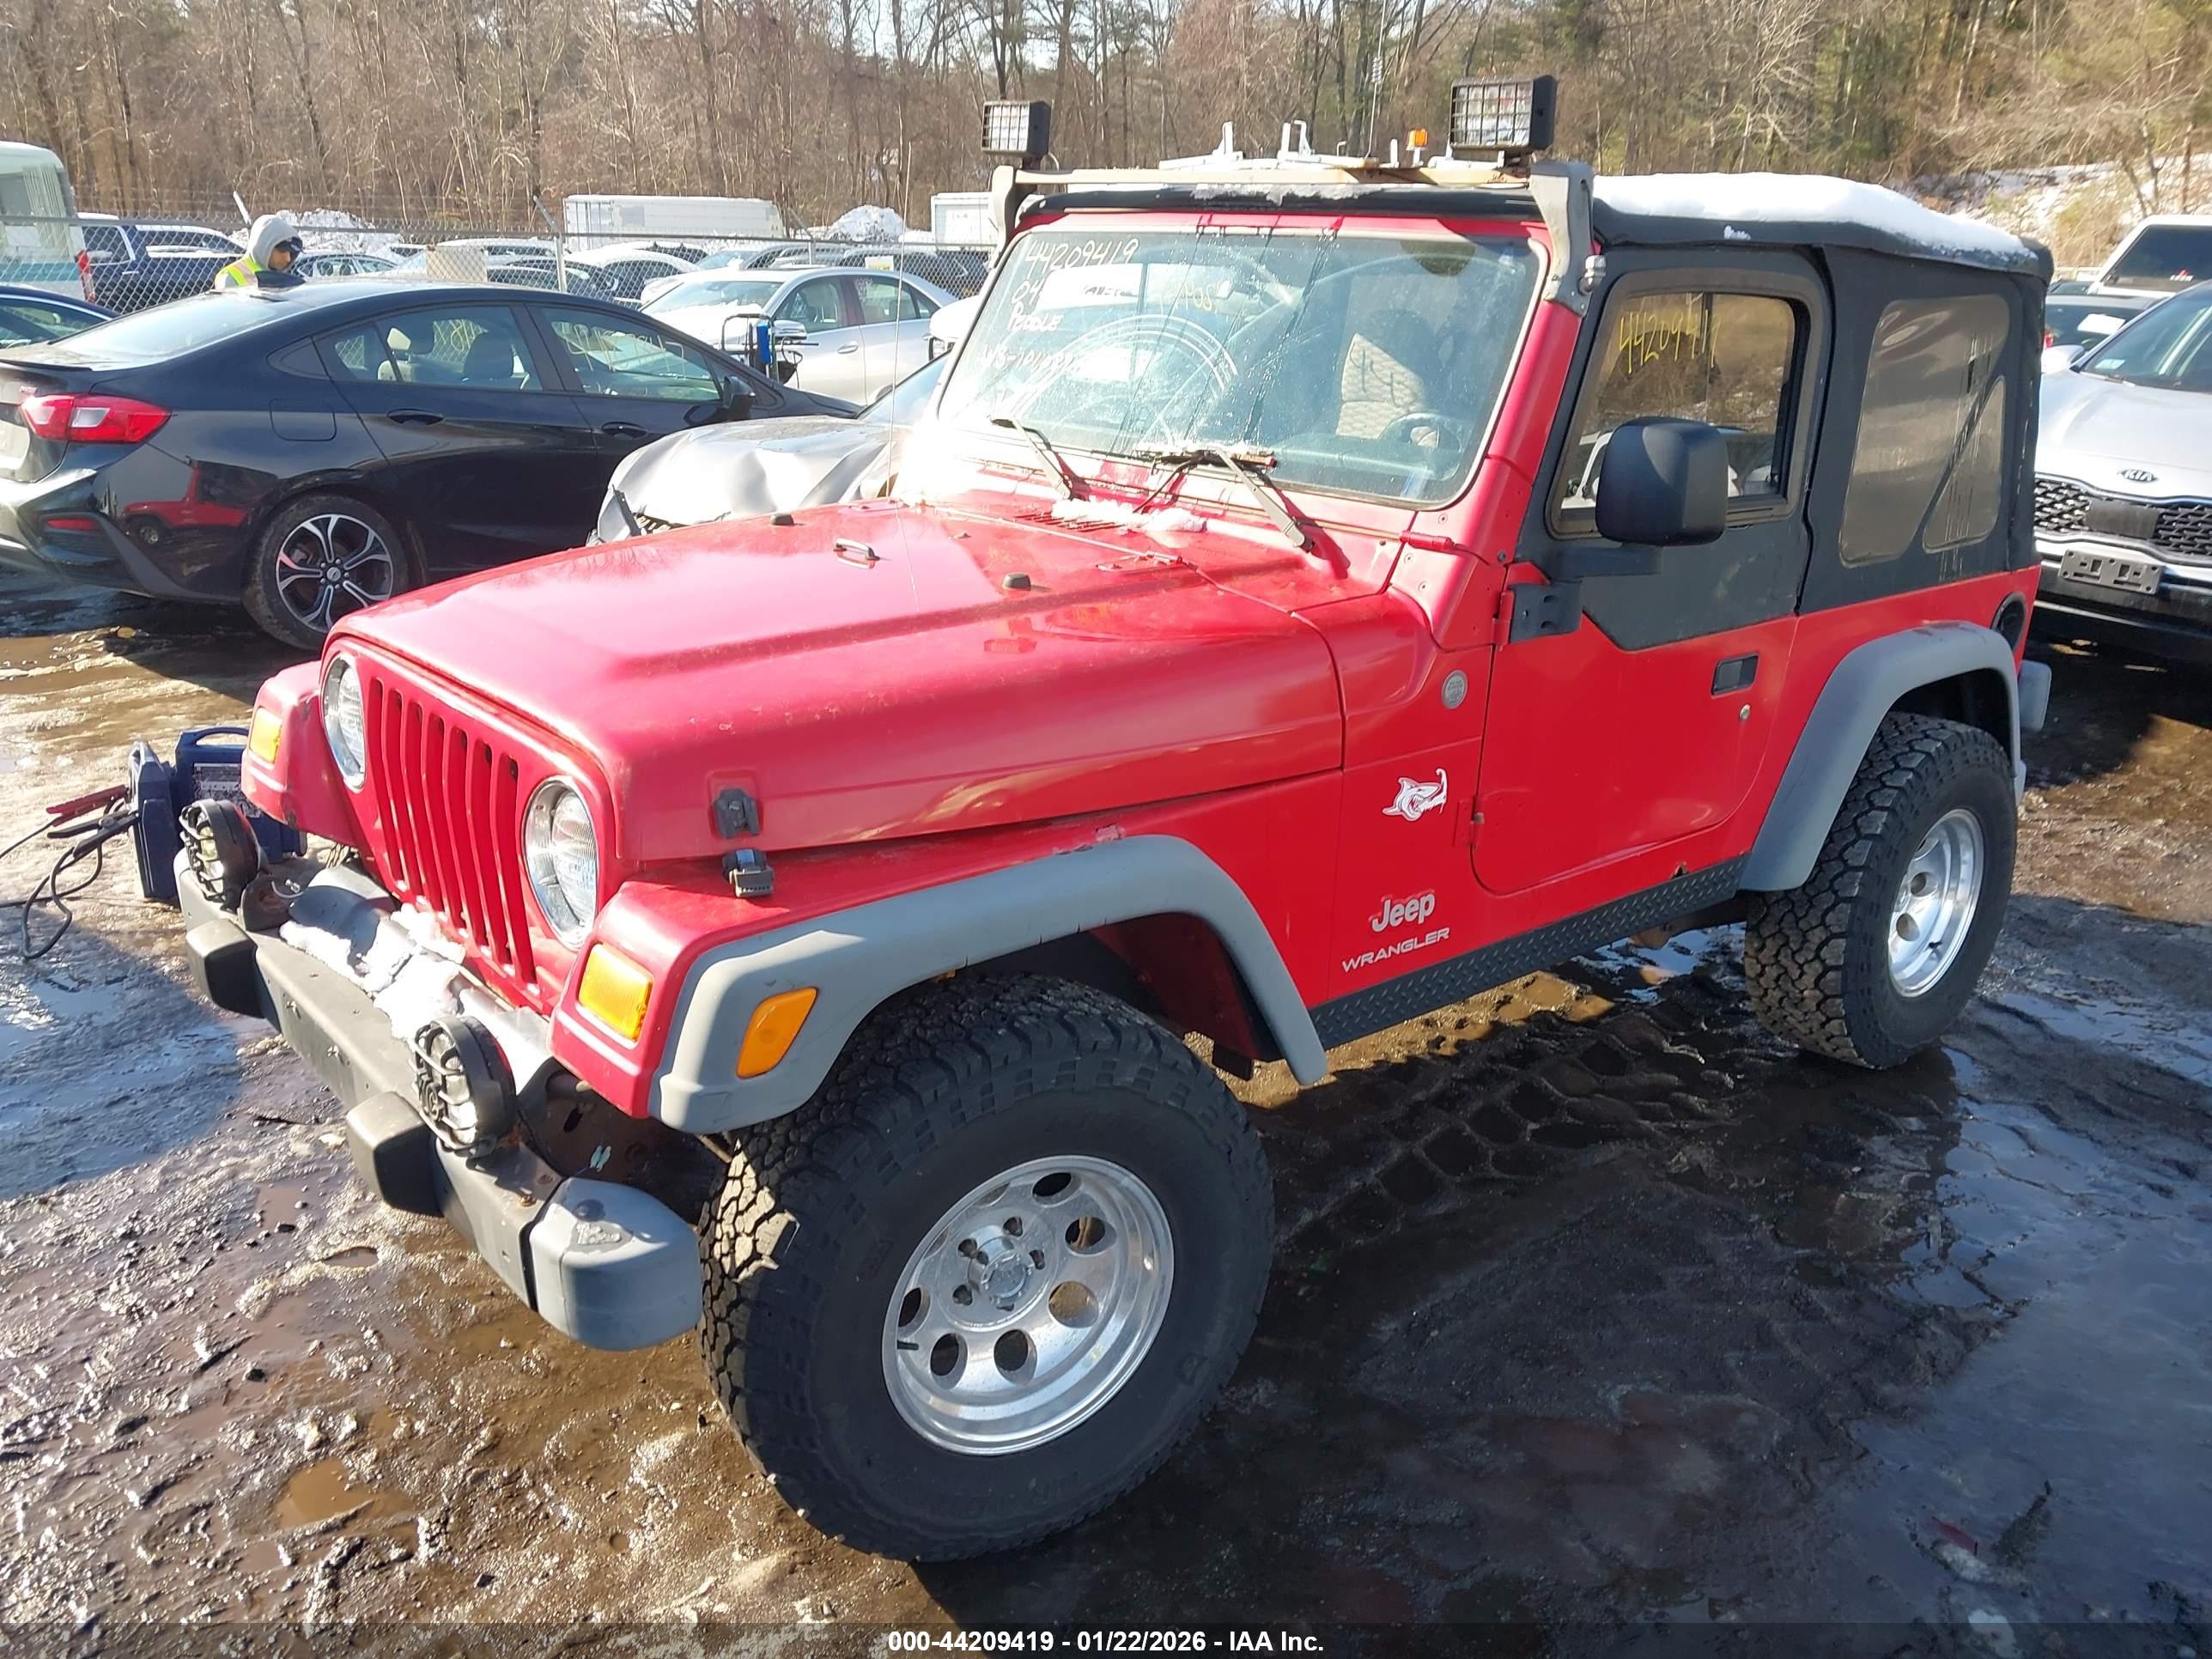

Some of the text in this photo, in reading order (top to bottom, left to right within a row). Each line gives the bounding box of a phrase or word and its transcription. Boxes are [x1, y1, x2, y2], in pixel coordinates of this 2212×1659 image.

[1024, 238, 1139, 280] 44209419
[1619, 309, 1722, 374] 44209419
[2120, 469, 2156, 482] KIA
[1371, 893, 1435, 932] Jeep
[1342, 927, 1449, 973] WRANGLER
